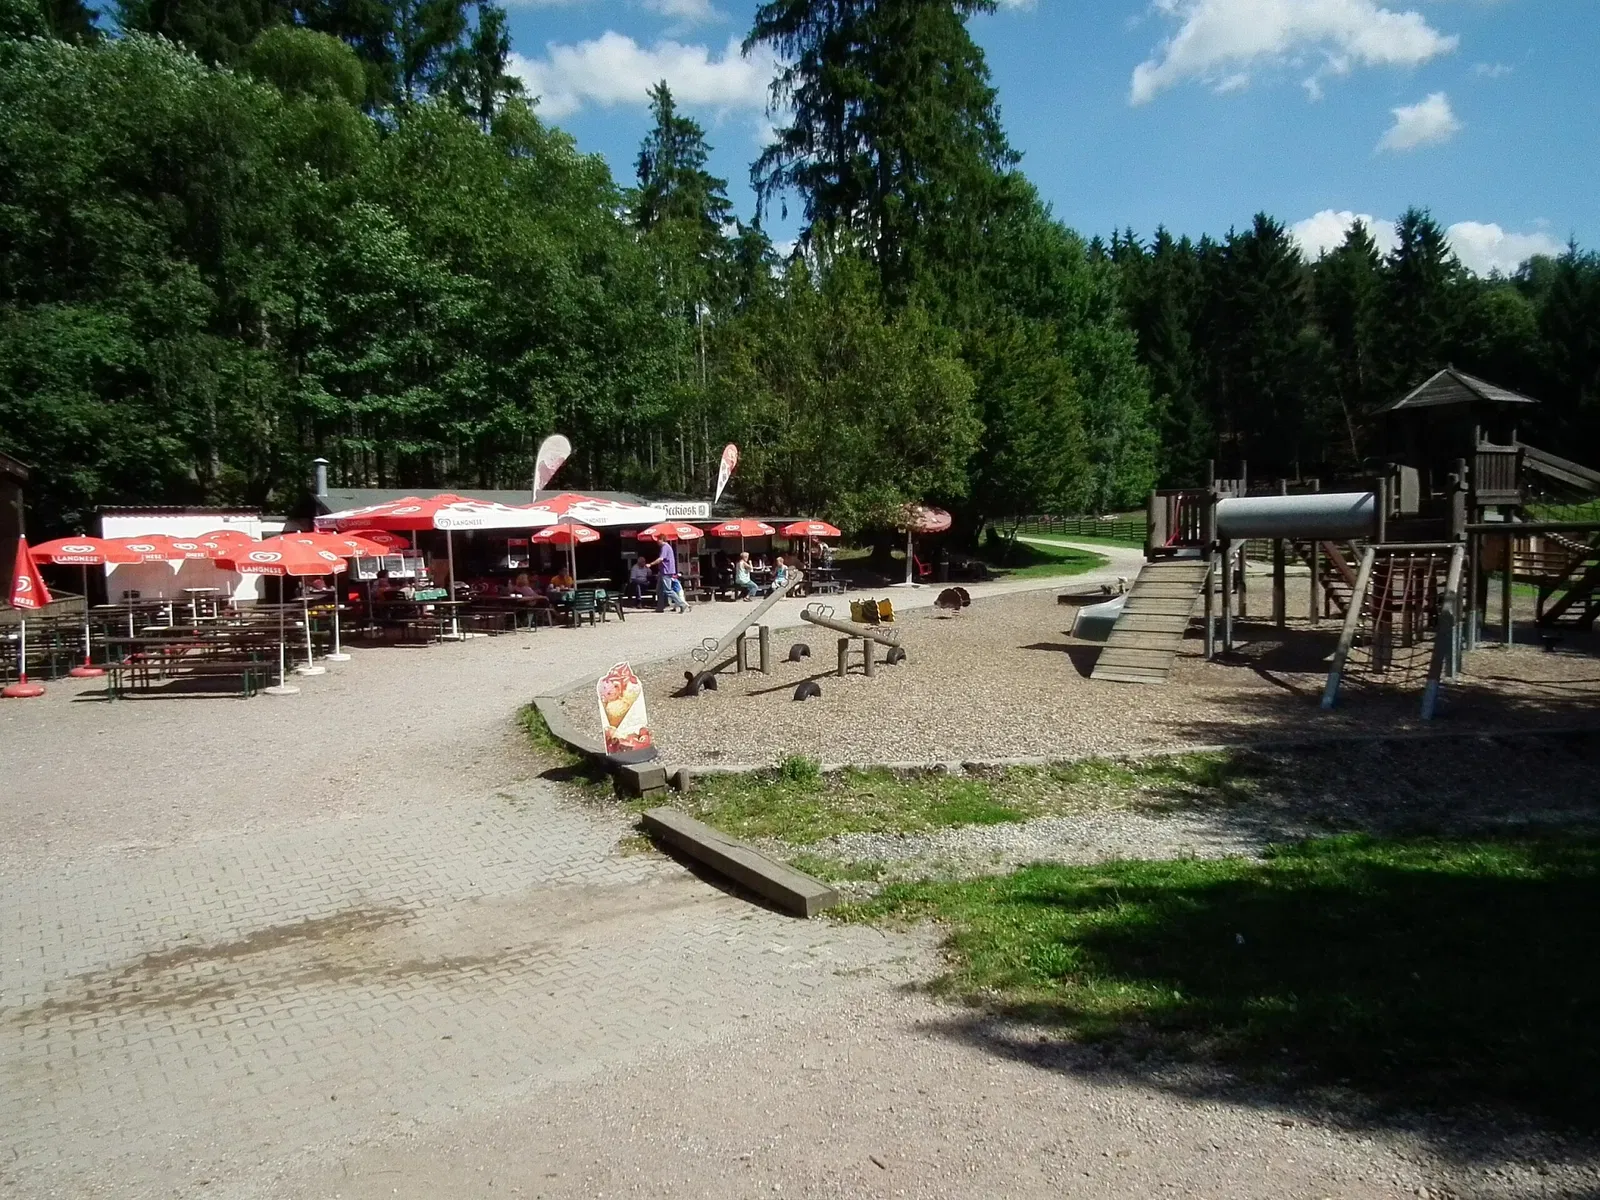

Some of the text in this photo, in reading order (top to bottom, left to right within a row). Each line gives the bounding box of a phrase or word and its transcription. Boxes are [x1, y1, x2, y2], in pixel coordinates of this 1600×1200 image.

[453, 519, 482, 527] LANGNESE
[56, 555, 99, 563] LANGNESE
[241, 565, 282, 575] LANGNESE
